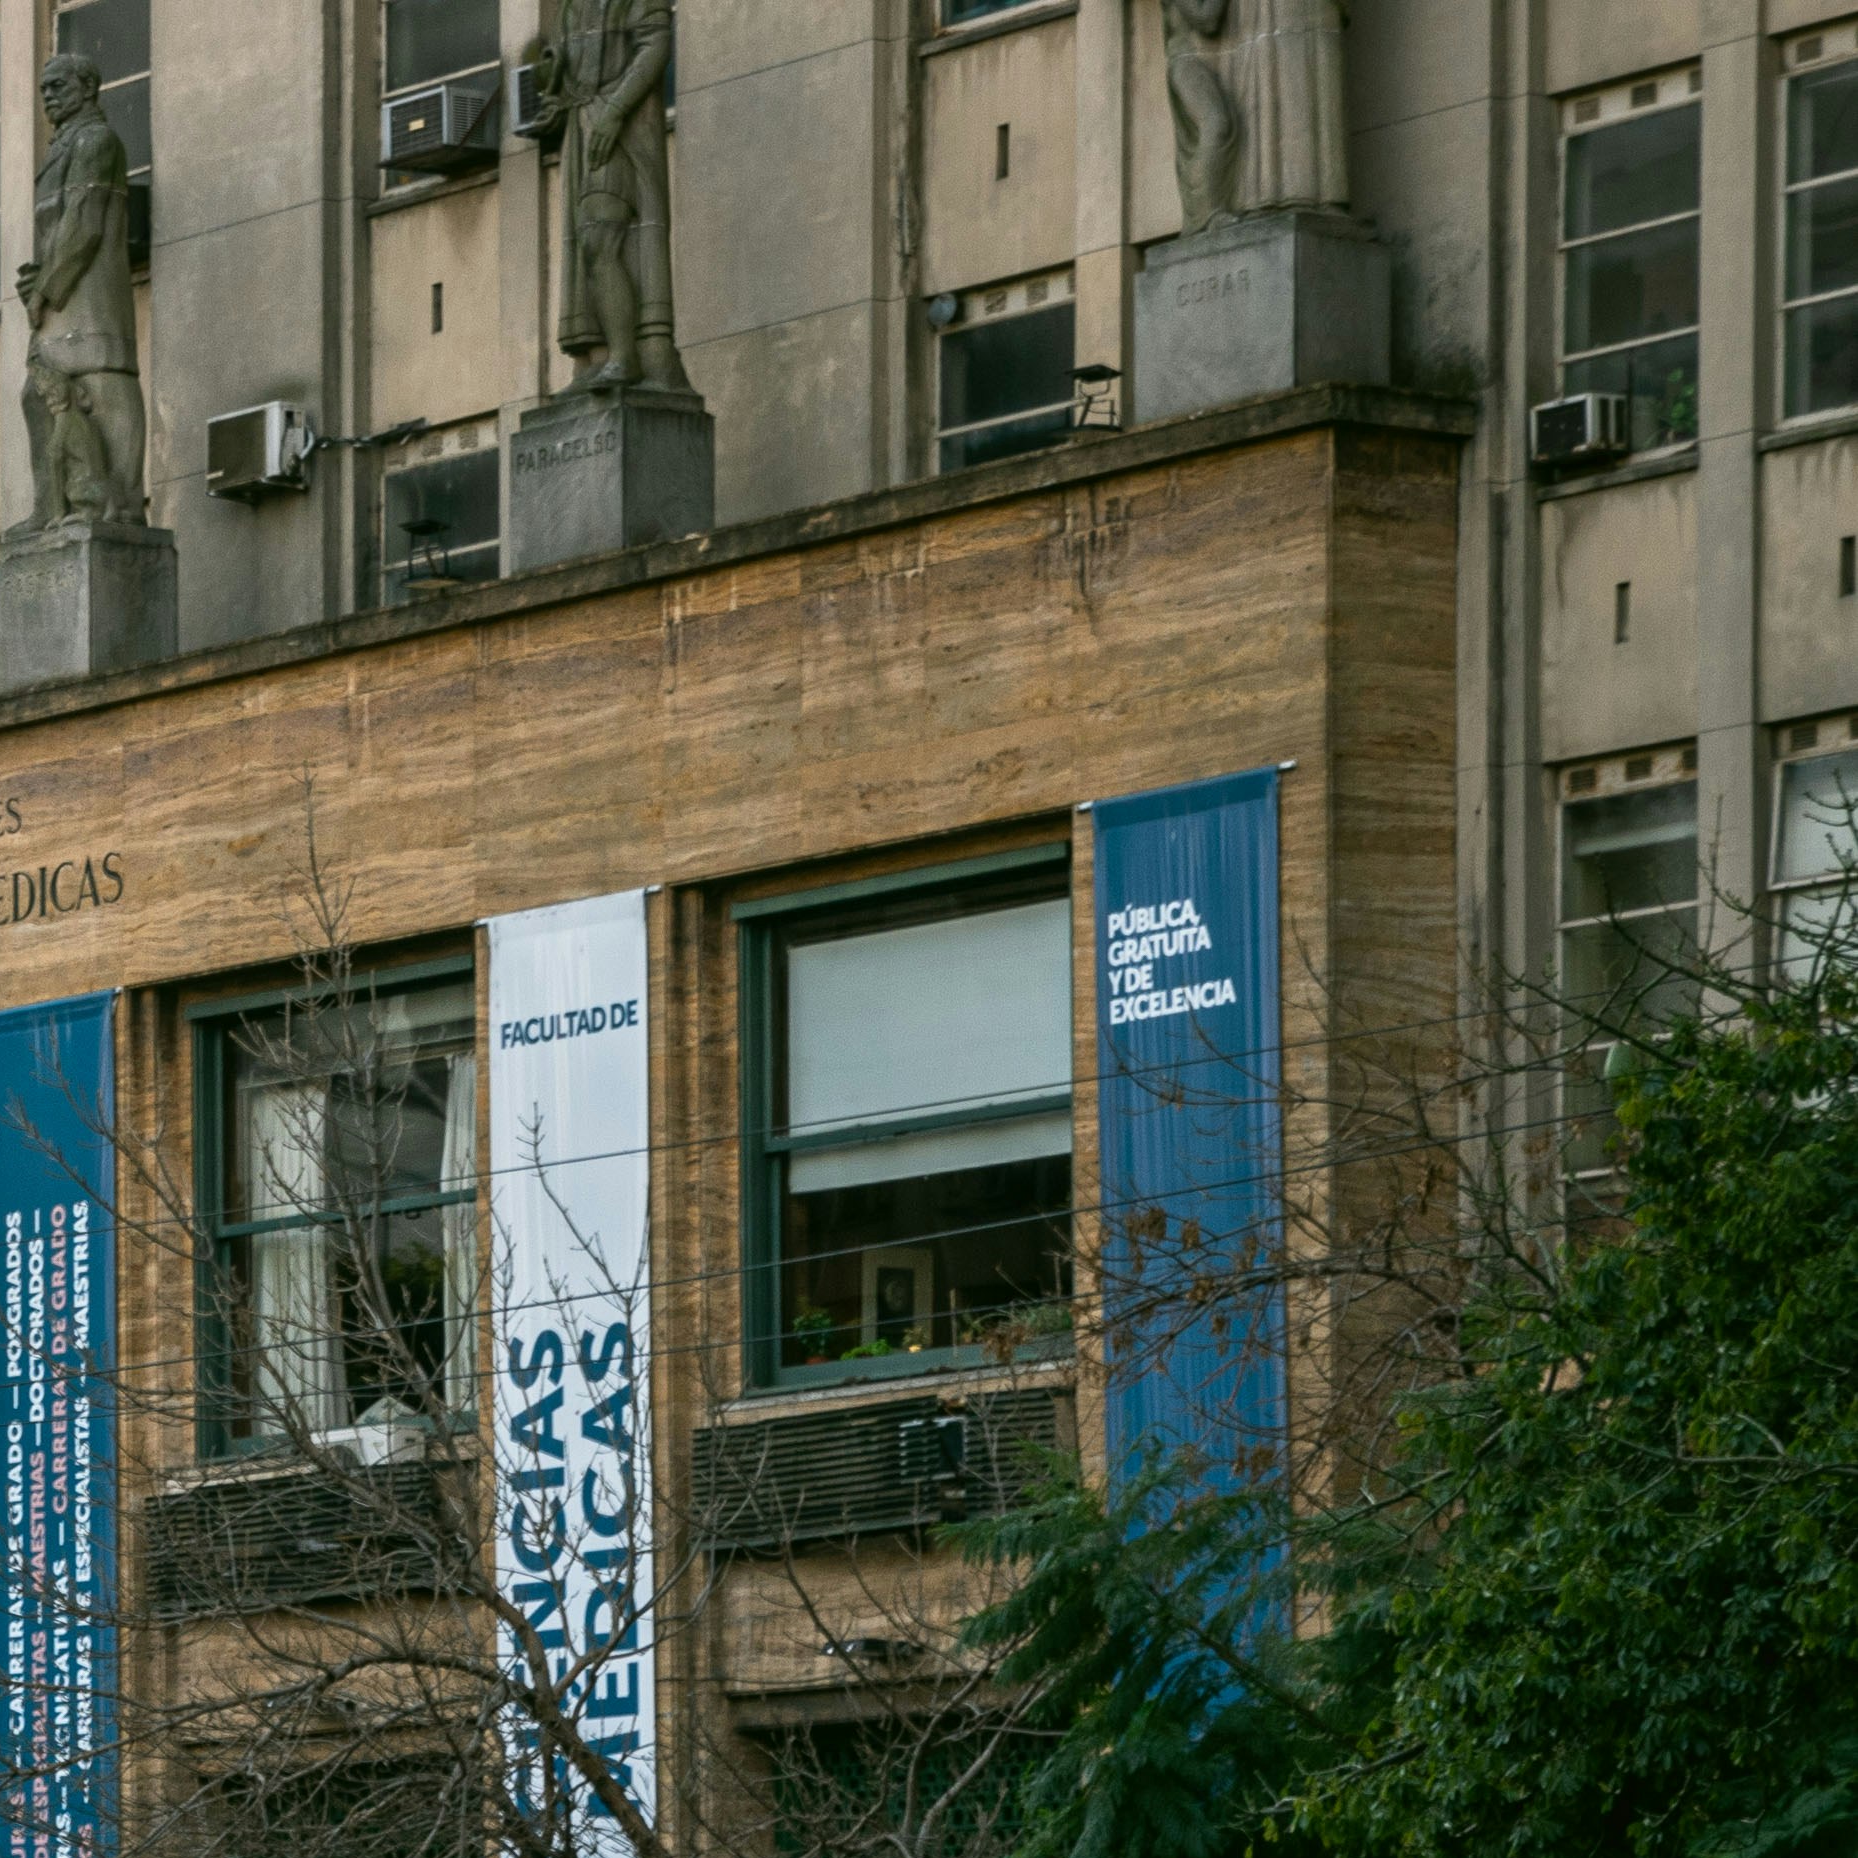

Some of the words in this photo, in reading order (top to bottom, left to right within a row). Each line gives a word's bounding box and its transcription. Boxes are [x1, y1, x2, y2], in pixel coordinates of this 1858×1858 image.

[1108, 899, 1200, 938] PÚBLICA,
[1108, 925, 1212, 967] GRATUITA
[500, 1005, 607, 1050] FACULTAD
[610, 999, 639, 1030] DE
[1108, 970, 1121, 996] Y
[1124, 963, 1153, 991] DE
[1109, 978, 1236, 1026] EXCELENCIA
[6, 1211, 21, 1378] POSGRADOS
[50, 1204, 67, 1310] GRADO
[73, 1200, 90, 1349] MAESTRIAS
[51, 1316, 67, 1355] DE
[7, 1420, 23, 1525] GRADO
[29, 1451, 45, 1593] MAESTRIAS
[509, 1329, 567, 1818] CIENCIAS
[570, 1322, 638, 1817] MÉDICAS
[8, 1583, 25, 1735] CARRERAS
